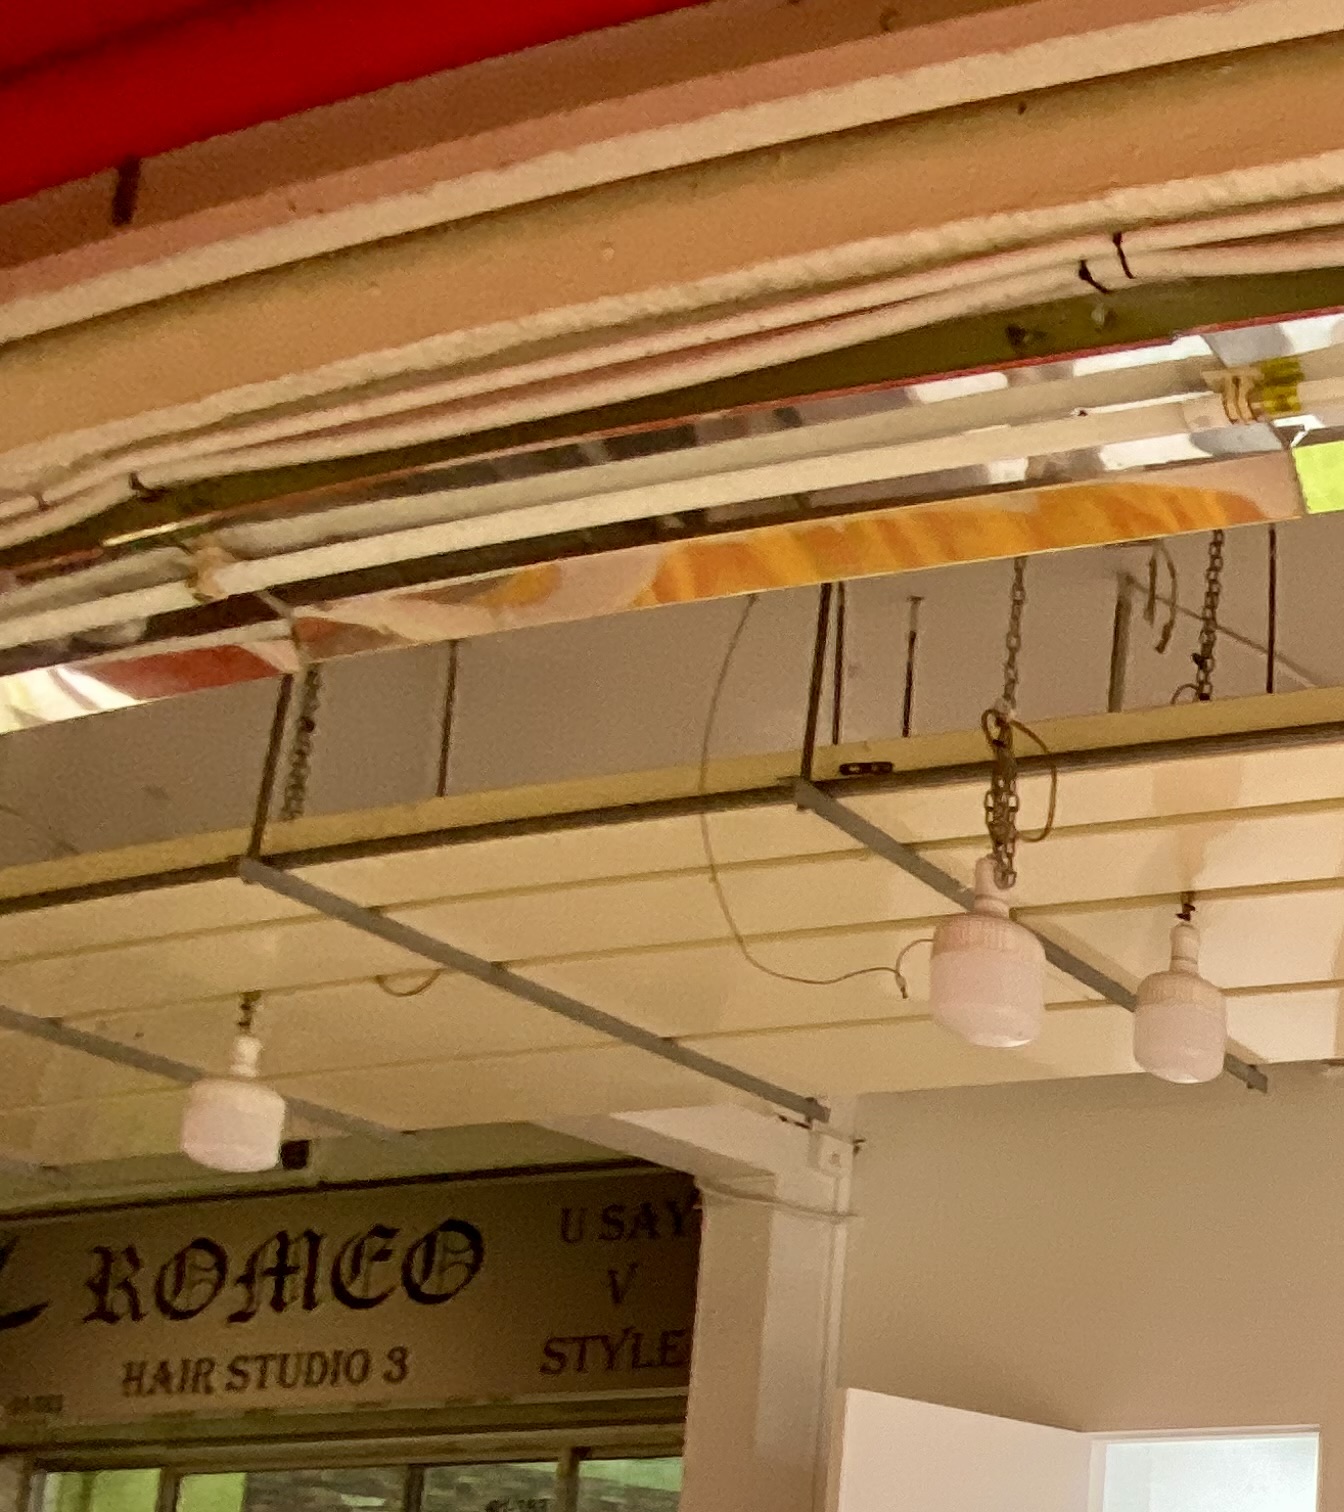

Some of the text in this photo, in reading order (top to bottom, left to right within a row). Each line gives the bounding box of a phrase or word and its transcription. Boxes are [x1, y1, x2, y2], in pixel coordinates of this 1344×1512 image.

[560, 1207, 588, 1243] U
[83, 1219, 484, 1324] ROMEO
[122, 1346, 409, 1398] HAIR STUDIO 3
[538, 1326, 689, 1375] STYLE
